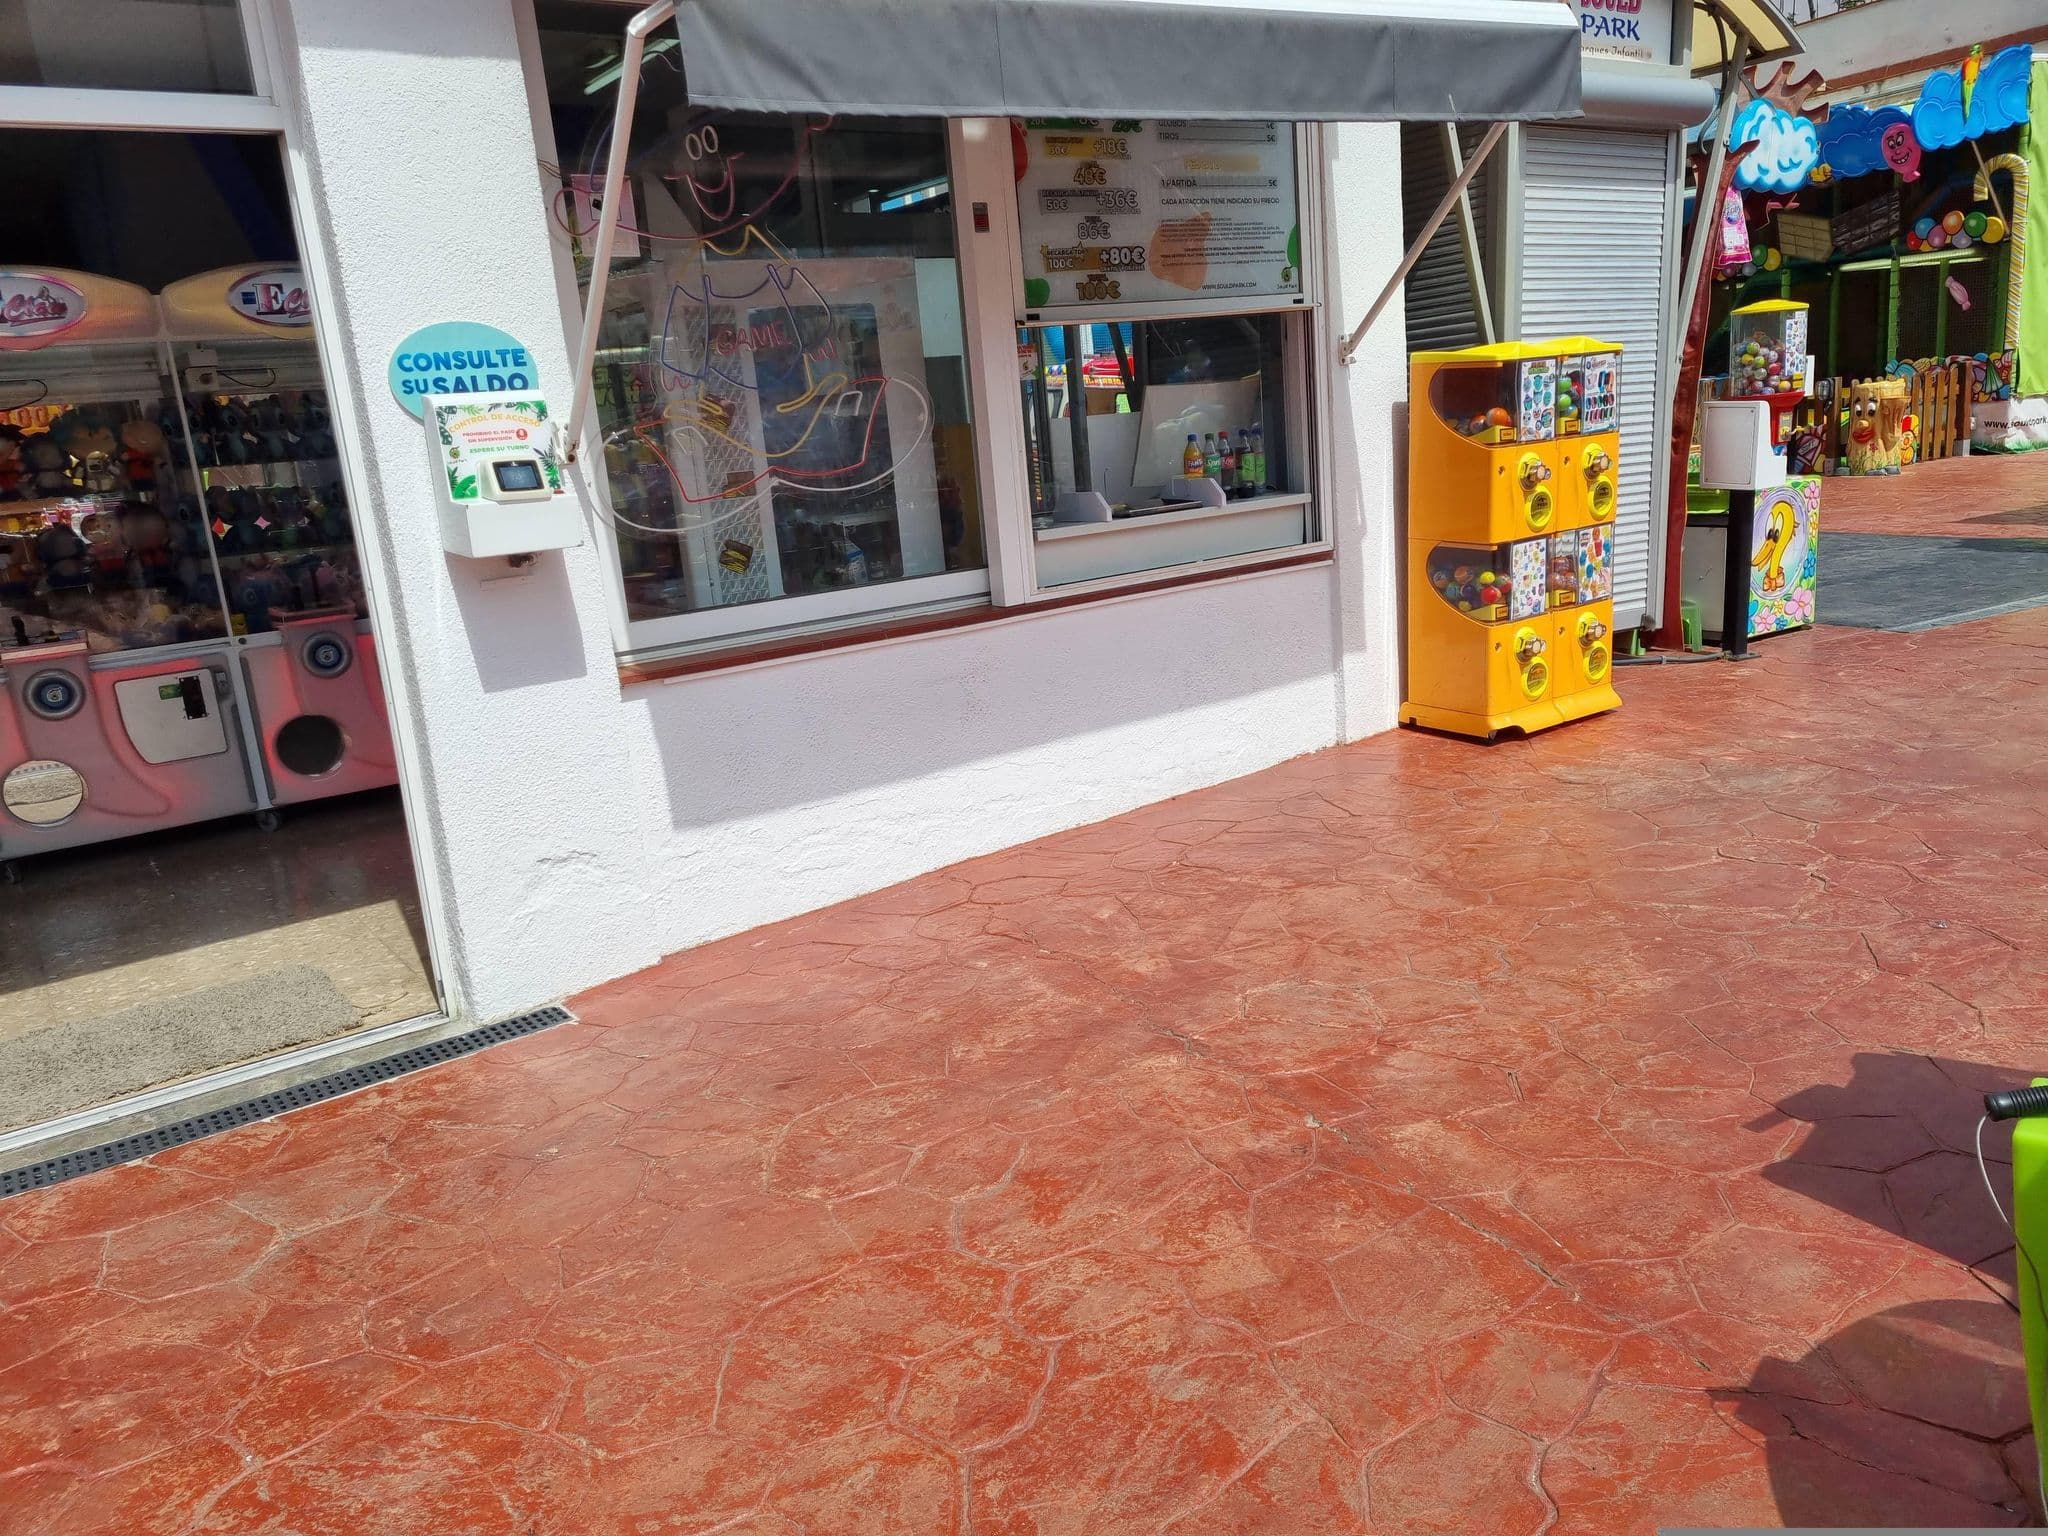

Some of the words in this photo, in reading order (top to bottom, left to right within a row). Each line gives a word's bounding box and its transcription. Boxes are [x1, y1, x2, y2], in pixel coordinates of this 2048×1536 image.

[1580, 13, 1640, 41] PARK
[1580, 45, 1609, 54] arques
[1094, 138, 1128, 155] +18€
[1073, 167, 1107, 186] 48€
[1166, 179, 1197, 188] PARTIDA
[1046, 199, 1069, 211] 50€
[1096, 190, 1139, 208] +36€
[1077, 222, 1111, 240] 86€
[1047, 258, 1074, 270] 100€
[1100, 246, 1145, 265] +80€
[397, 348, 527, 373] CONSULTE
[402, 378, 428, 395] SU
[432, 373, 529, 394] SALDO
[448, 414, 489, 433] CONTROL
[506, 413, 541, 428] ACCESO
